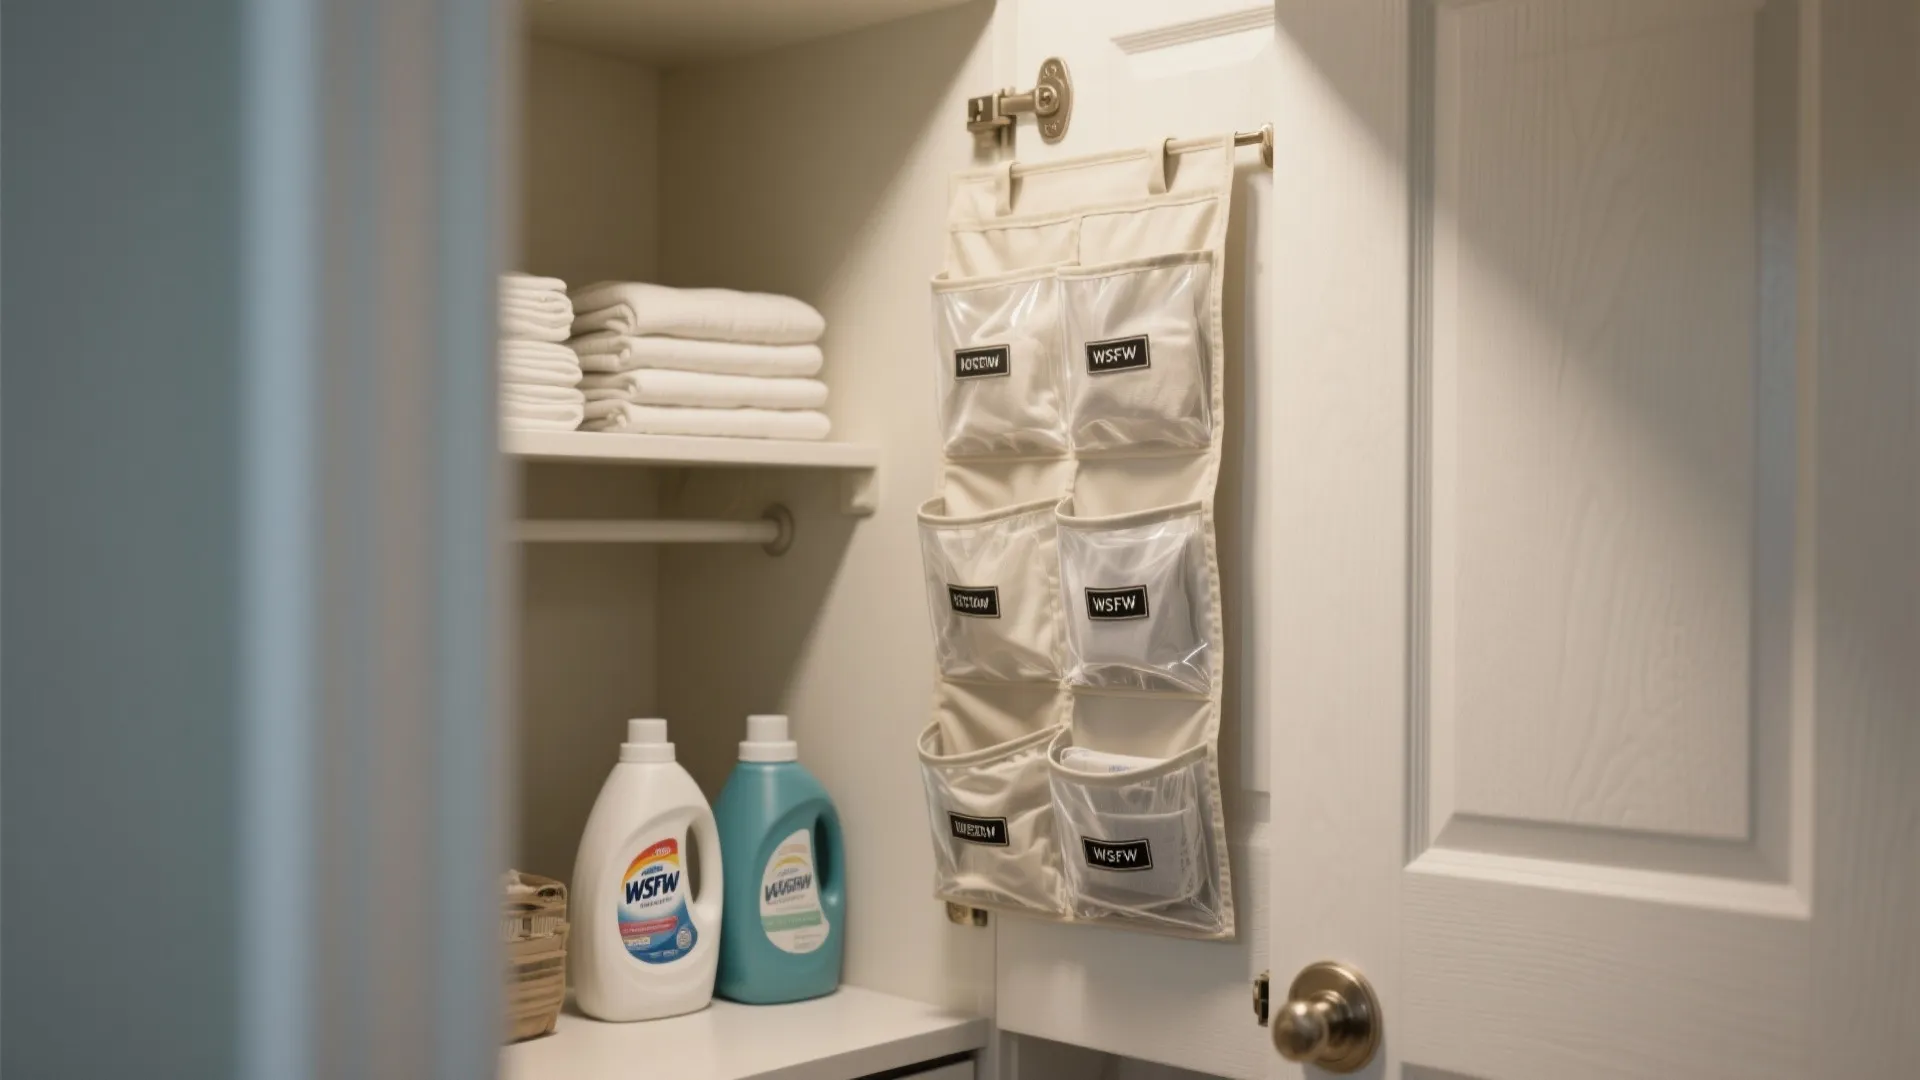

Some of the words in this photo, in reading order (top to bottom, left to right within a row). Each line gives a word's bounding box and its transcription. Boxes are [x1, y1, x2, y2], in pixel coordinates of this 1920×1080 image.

[1093, 345, 1137, 365] WSFW
[1093, 595, 1136, 612] WSFW
[1093, 846, 1137, 863] WSFW
[626, 870, 680, 904] WSFW
